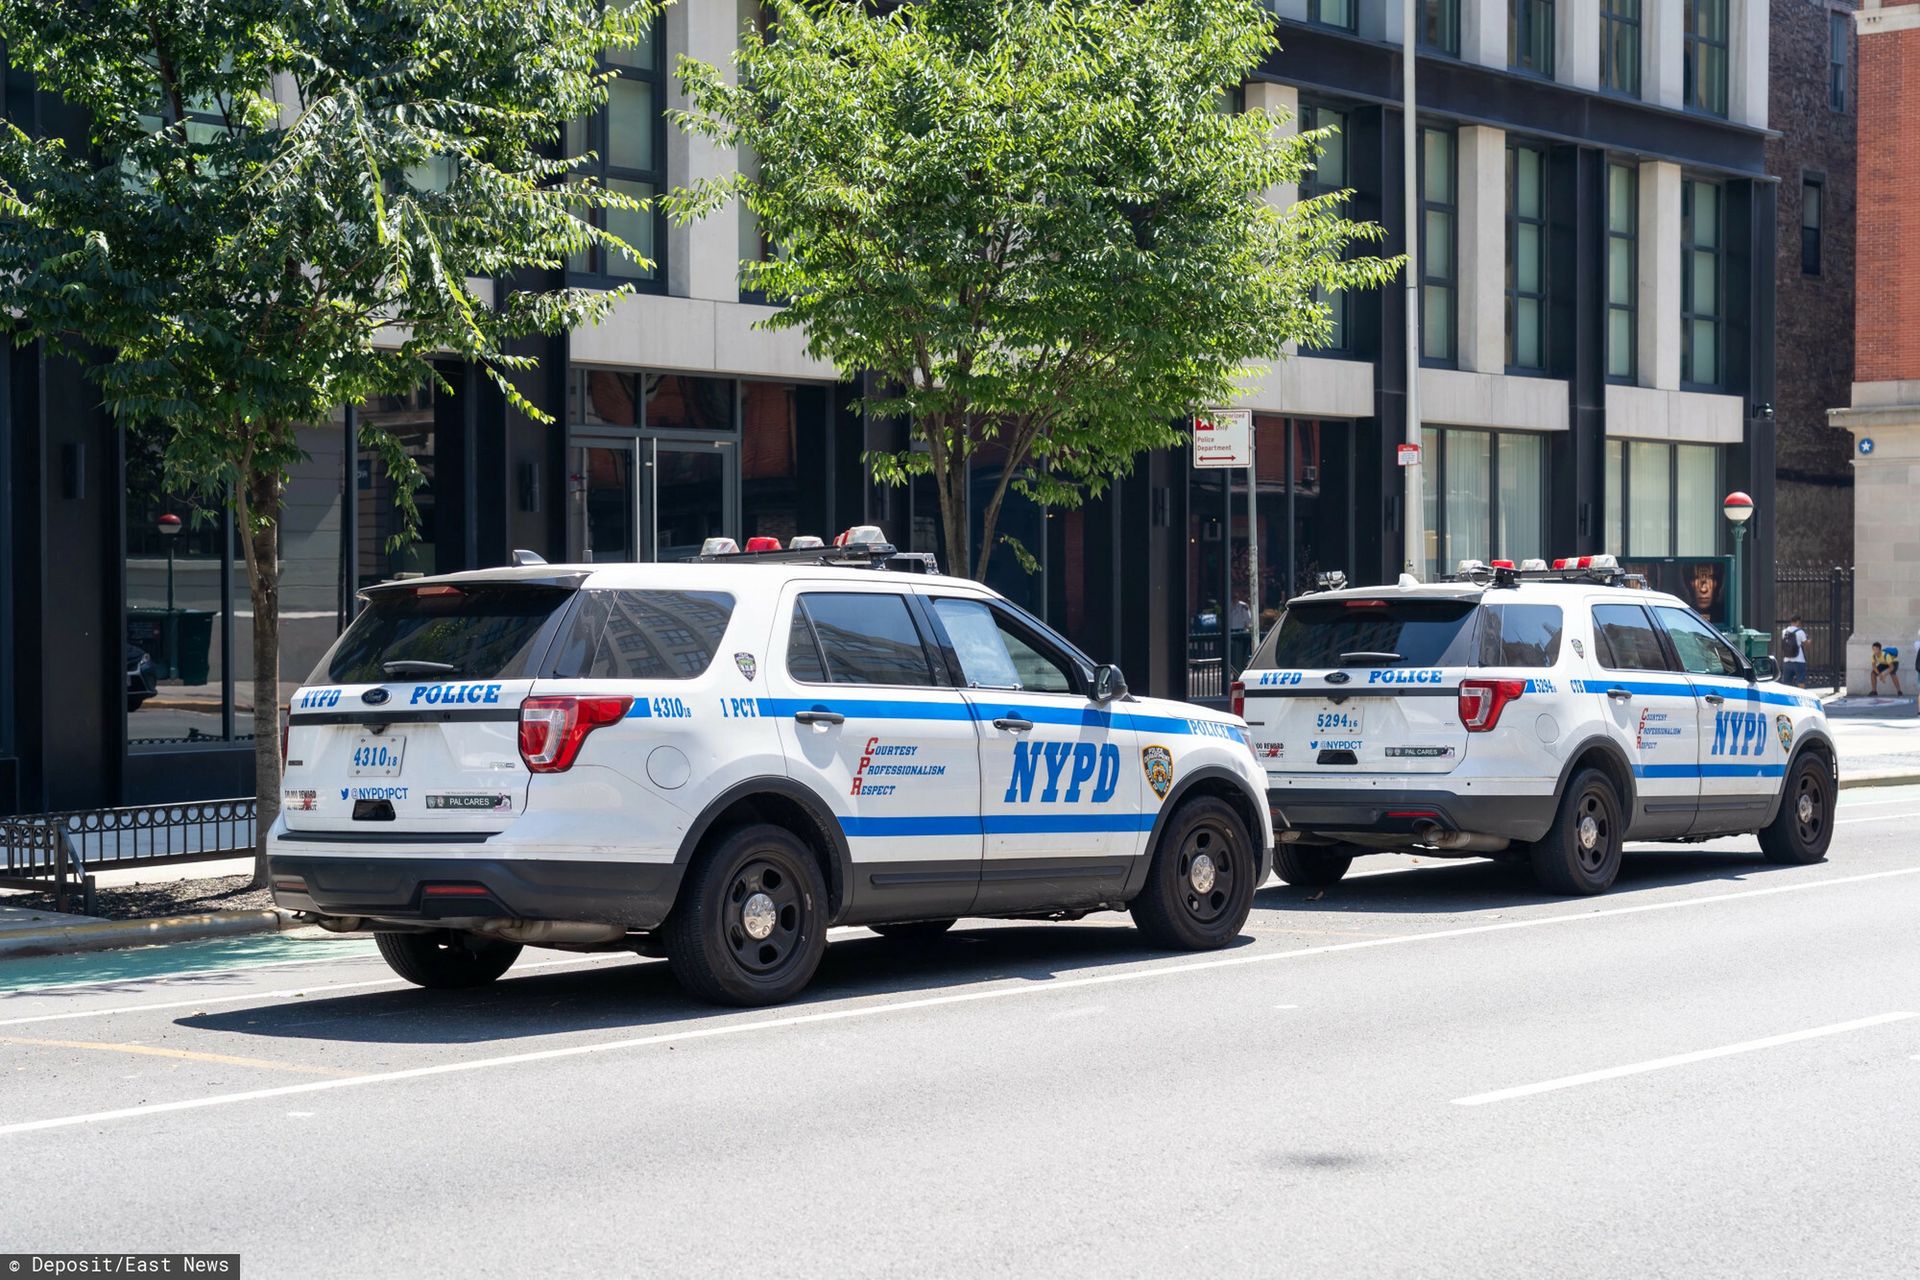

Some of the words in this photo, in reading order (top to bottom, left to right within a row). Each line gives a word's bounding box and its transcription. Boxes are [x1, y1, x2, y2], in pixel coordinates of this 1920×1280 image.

[1197, 444, 1232, 452] Department
[1259, 671, 1303, 685] NYPD
[1368, 670, 1443, 684] POLICE
[300, 689, 342, 708] NYPD
[410, 684, 502, 704] POLICE
[720, 698, 728, 718] 1
[730, 698, 756, 718] PCT
[1189, 719, 1229, 739] POLICE
[1711, 711, 1767, 756] NYPD
[865, 737, 918, 755] COURTESY
[857, 756, 946, 775] PROFESSIONALISM
[1004, 741, 1120, 803] NYPD
[351, 787, 409, 799] @NYPD1PCT
[850, 777, 896, 795] RESPECT
[449, 797, 463, 806] PAL
[464, 797, 490, 806] CARES
